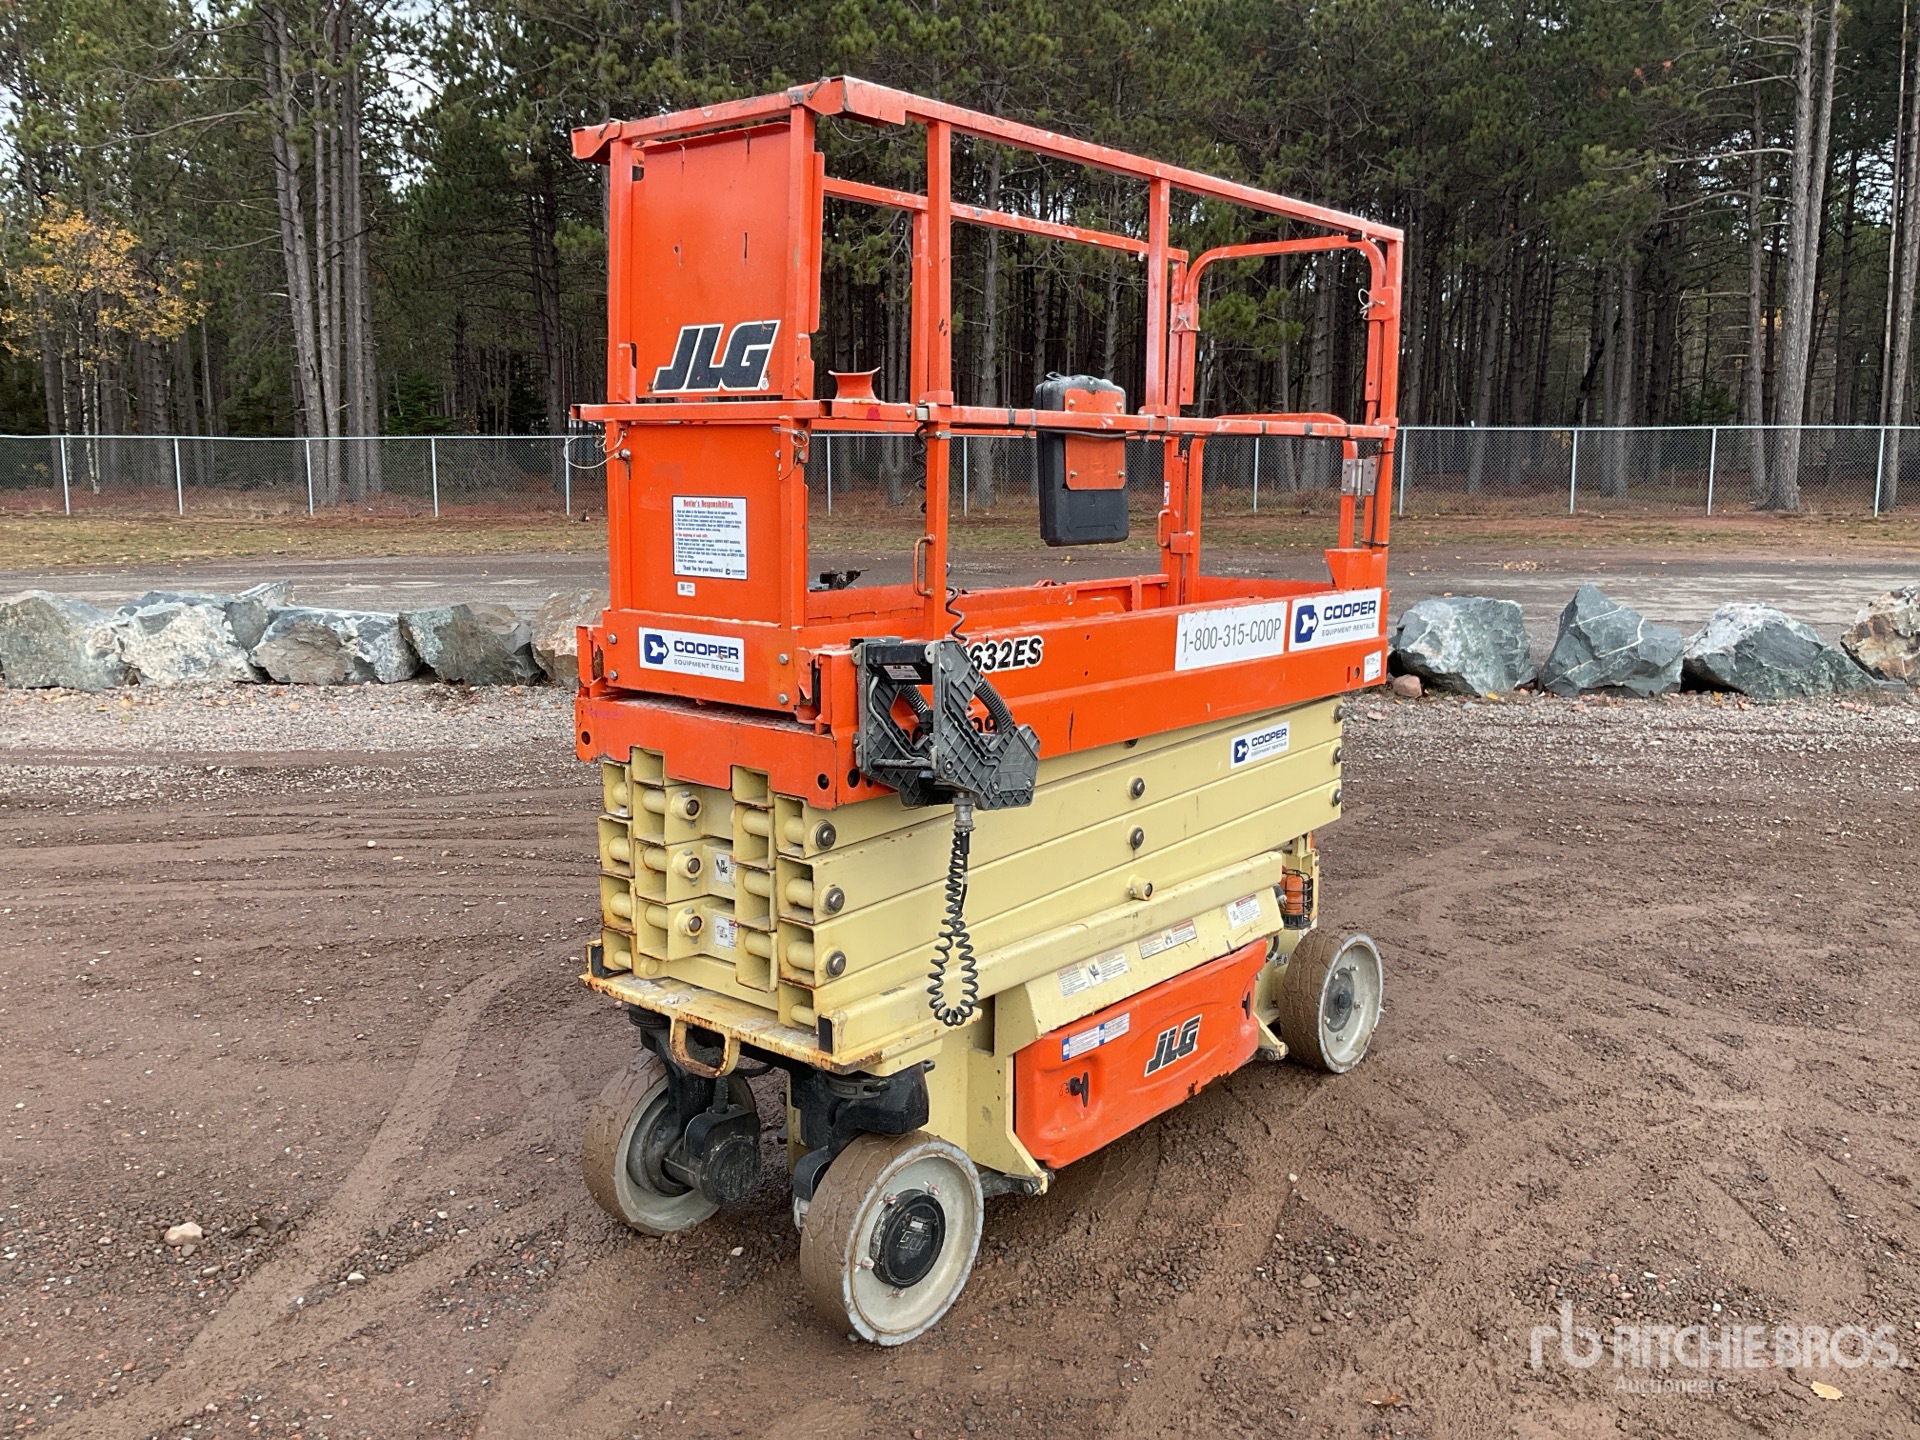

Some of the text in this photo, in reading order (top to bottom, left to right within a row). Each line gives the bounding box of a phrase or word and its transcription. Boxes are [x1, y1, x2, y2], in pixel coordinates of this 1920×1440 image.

[653, 320, 781, 393] JLG
[1324, 600, 1376, 621] COOPER
[1182, 617, 1282, 653] 1-800-315-COOP
[1322, 622, 1375, 637] EQUIPMENT RENTALS
[674, 640, 739, 660] COOPER
[674, 658, 739, 673] EQUIPMENT RENTALS
[1251, 728, 1287, 747] COOPER
[1144, 1013, 1202, 1077] JLG
